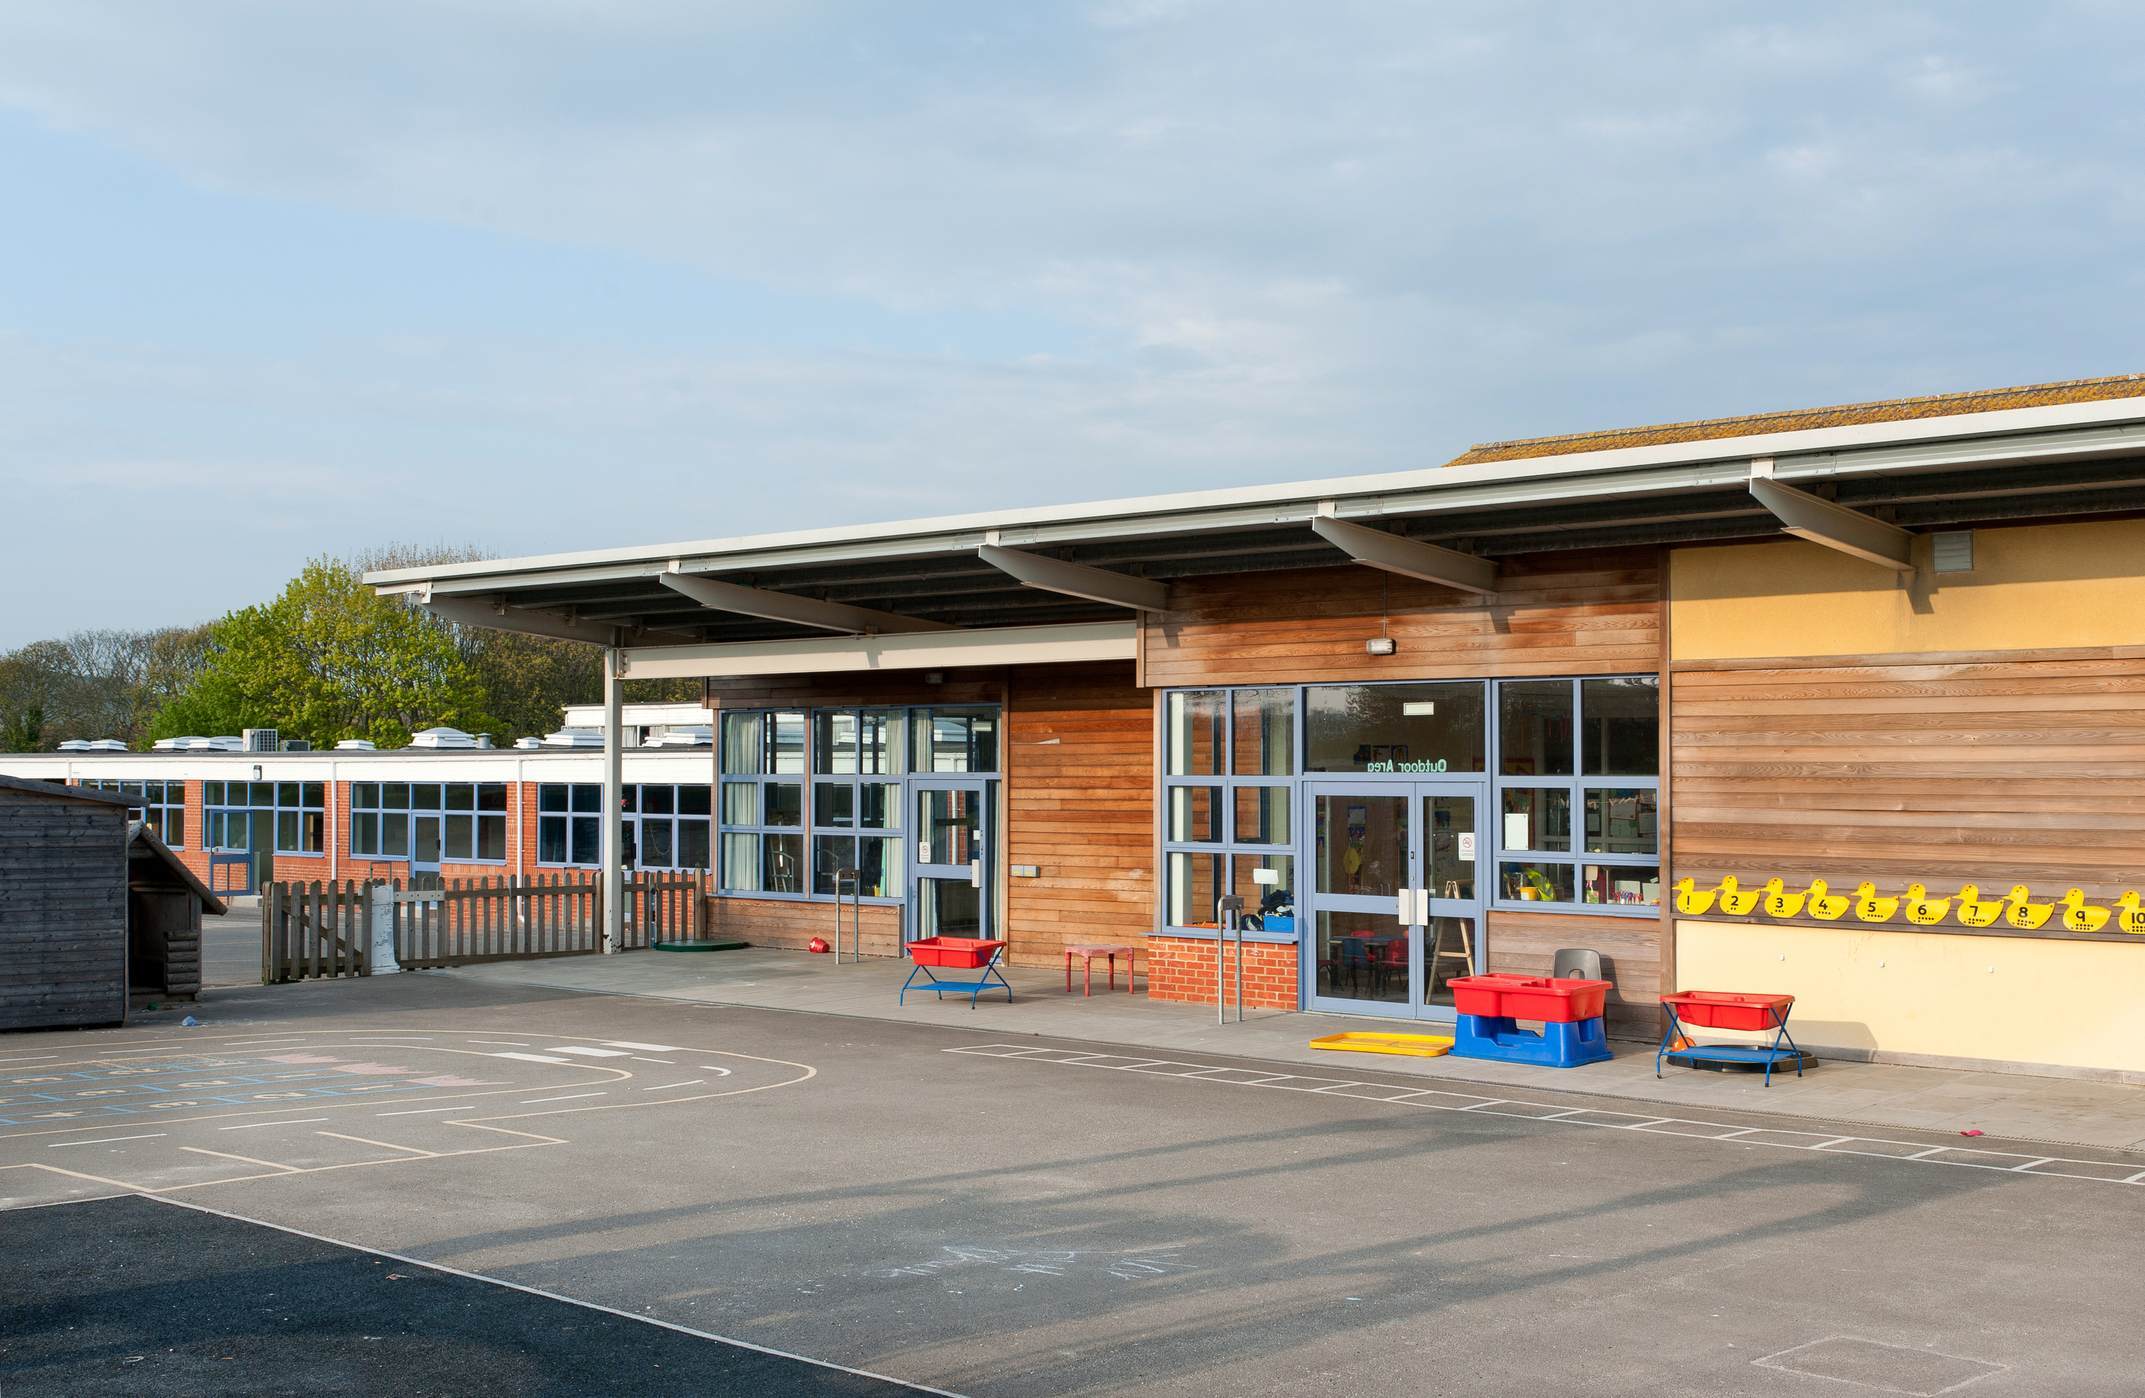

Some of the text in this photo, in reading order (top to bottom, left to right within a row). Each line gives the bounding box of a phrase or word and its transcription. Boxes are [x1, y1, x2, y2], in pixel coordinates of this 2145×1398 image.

[1731, 895, 1739, 906] 2
[1775, 897, 1784, 908] 3
[1818, 899, 1828, 910] 4
[1867, 901, 1876, 912] 5
[1918, 904, 1927, 915] 6
[1969, 905, 1978, 917] 7
[2018, 906, 2028, 918] 8
[2075, 910, 2085, 922] 9
[2131, 912, 2145, 924] 10
